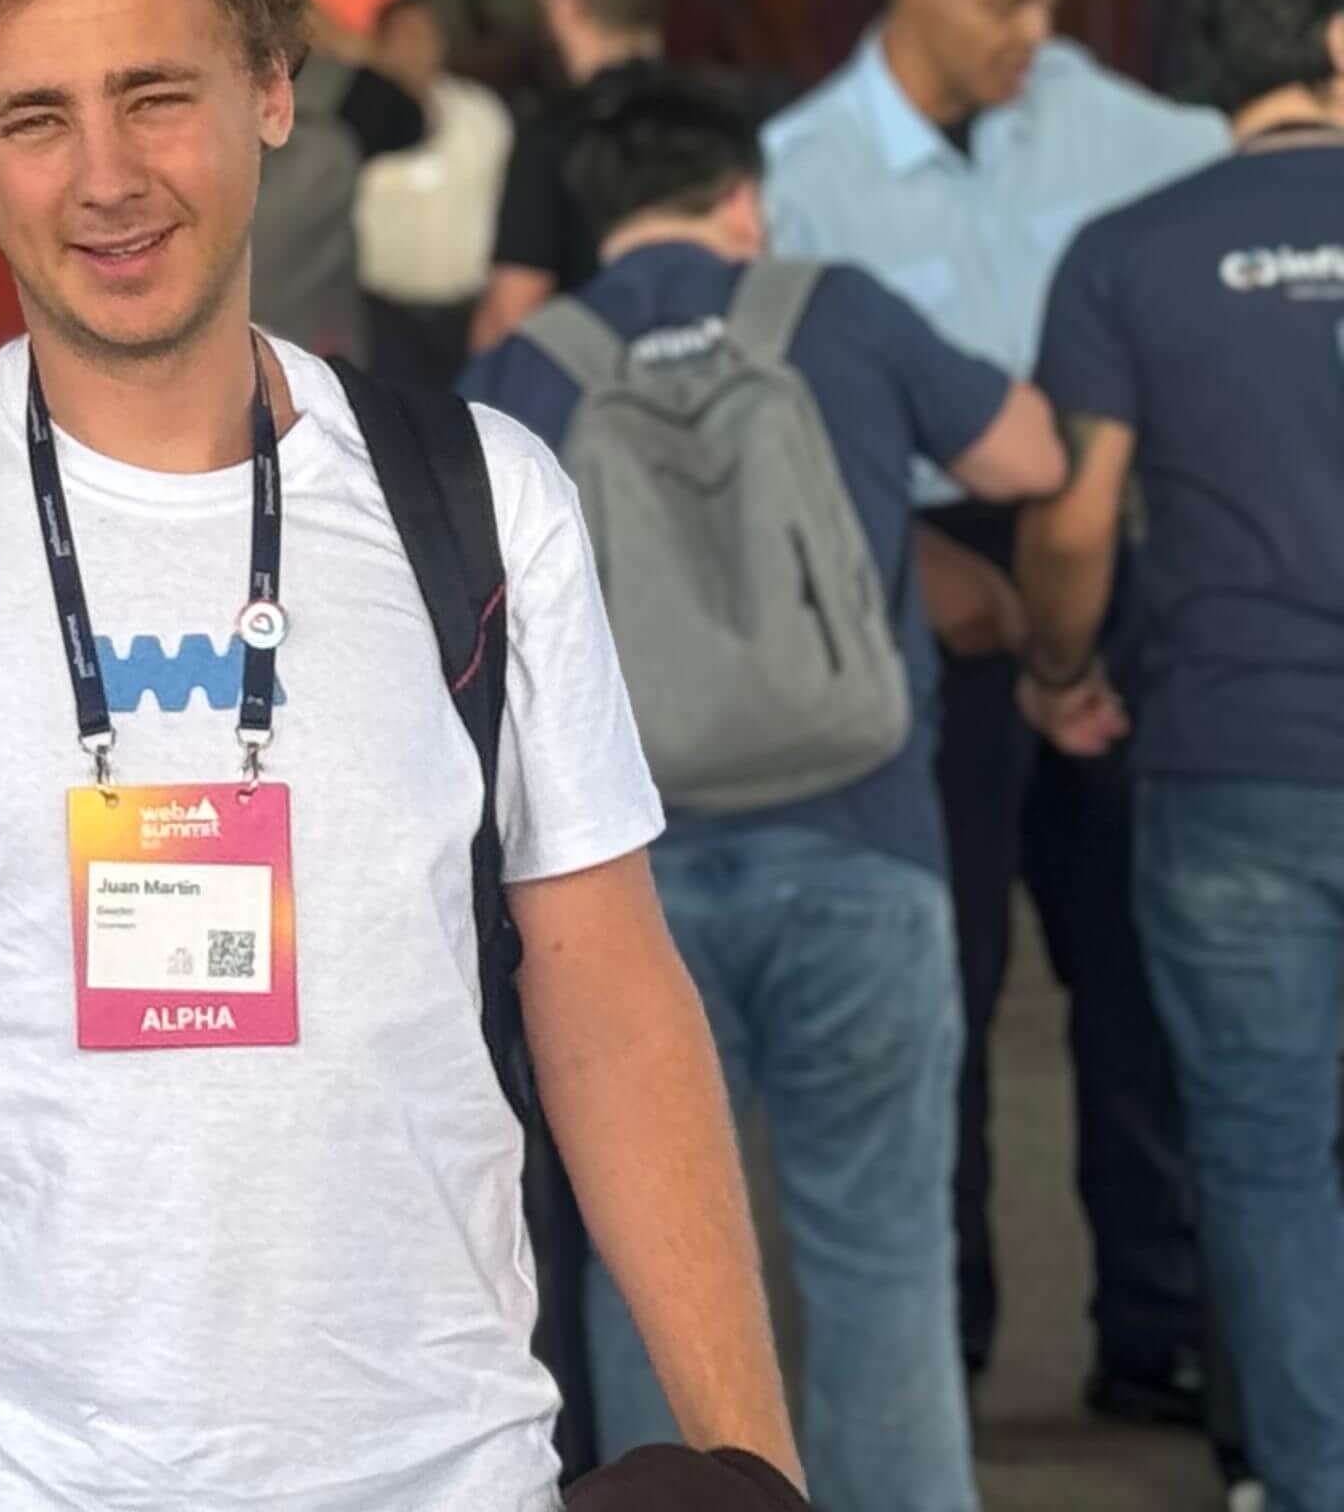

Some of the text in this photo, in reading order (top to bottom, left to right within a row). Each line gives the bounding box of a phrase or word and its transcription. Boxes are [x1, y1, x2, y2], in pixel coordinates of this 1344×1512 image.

[139, 801, 186, 821] web
[140, 820, 221, 838] summit
[97, 878, 140, 896] Juan
[141, 1006, 236, 1031] ALPHA
